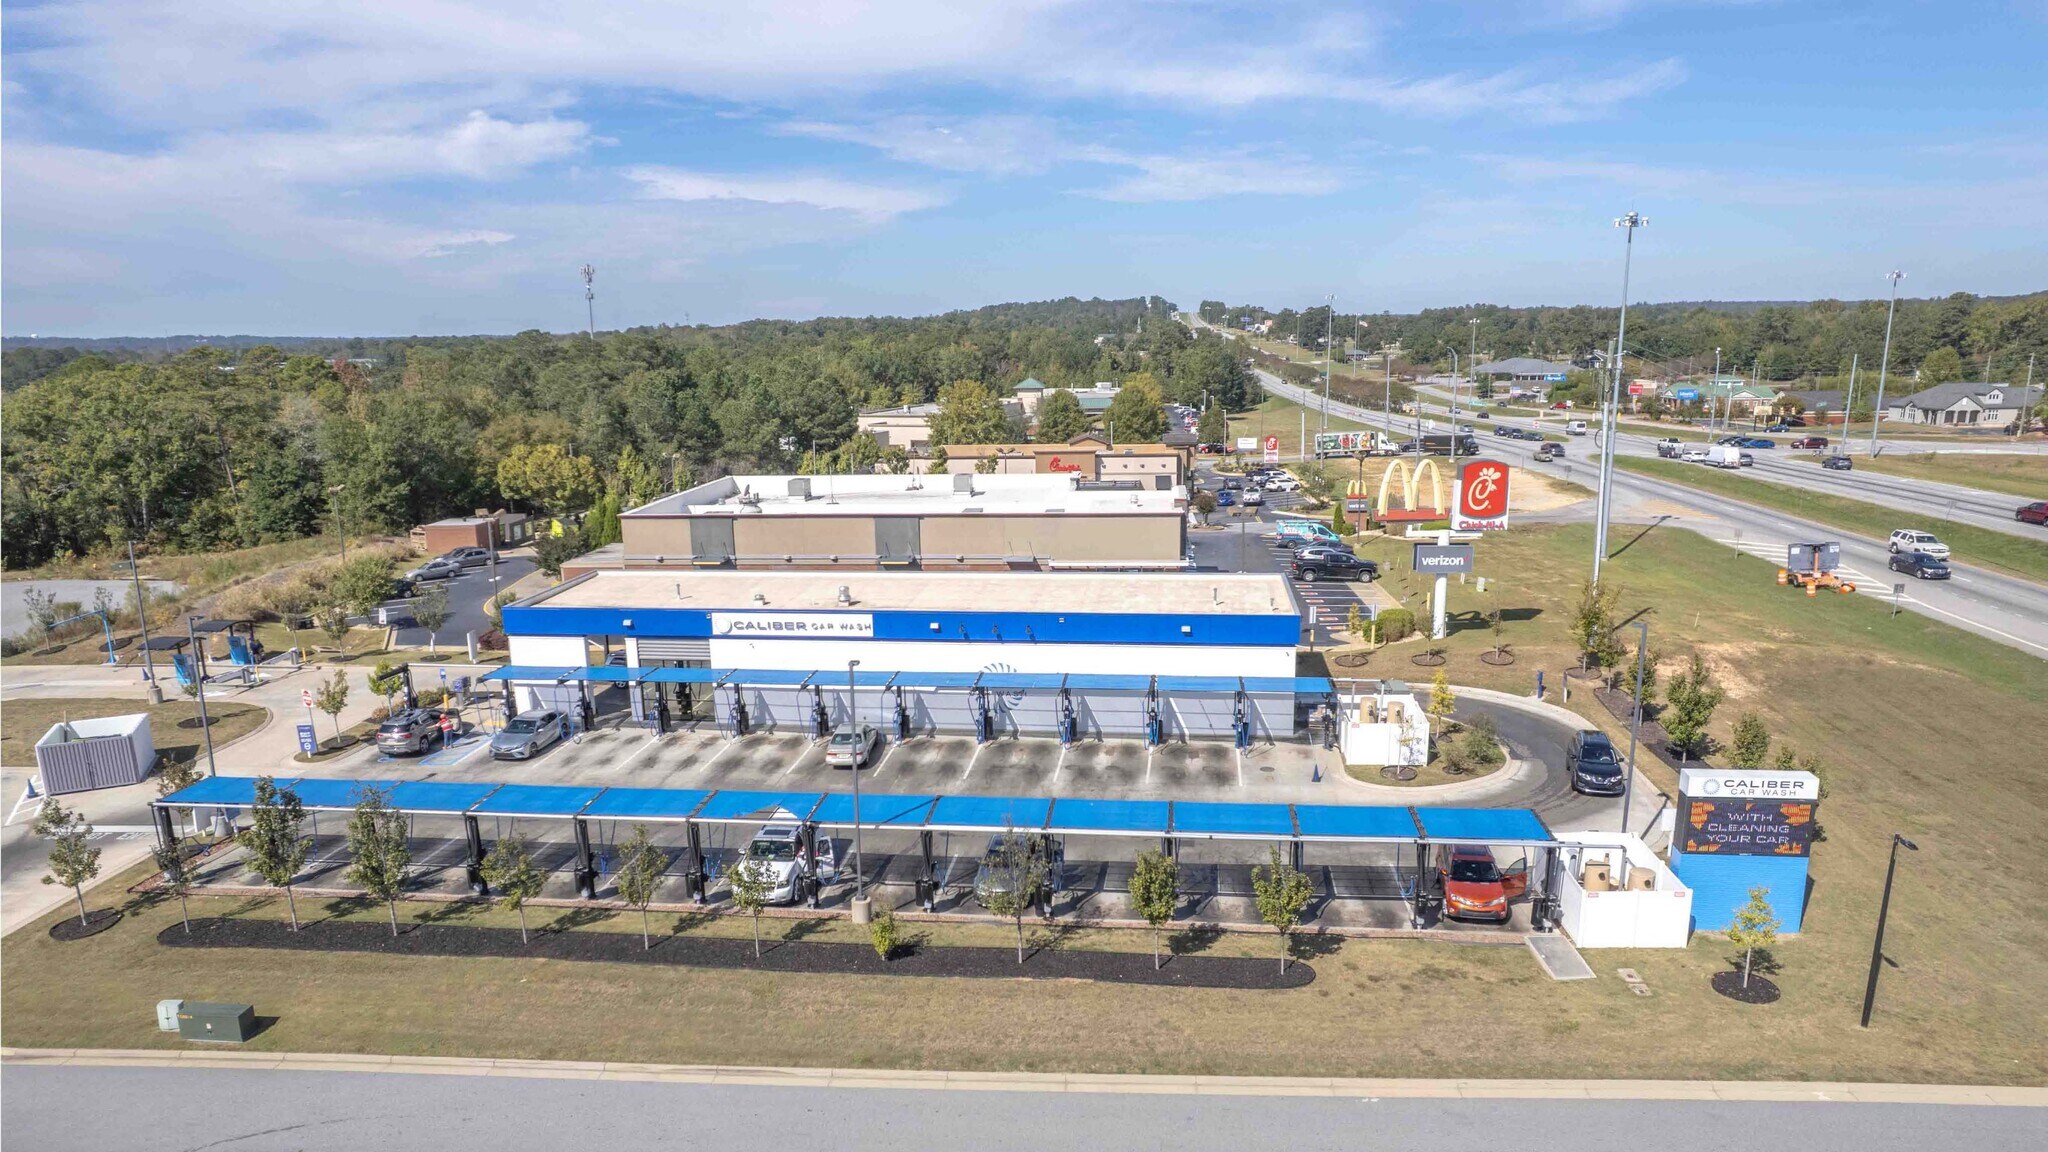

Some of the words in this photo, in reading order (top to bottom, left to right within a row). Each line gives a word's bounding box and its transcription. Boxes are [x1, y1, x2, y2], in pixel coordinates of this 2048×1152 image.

[1422, 554, 1464, 566] verizon
[733, 621, 808, 631] CALIBER
[811, 623, 835, 631] CAR
[839, 623, 872, 631] WASH
[1723, 779, 1805, 789] CALIBER
[1730, 788, 1756, 796] CAR
[1761, 789, 1797, 797] WASH
[1727, 812, 1774, 822] WITH
[1707, 823, 1791, 834] CLEANING
[1706, 834, 1752, 843] YOUR
[1755, 835, 1790, 844] CAR
